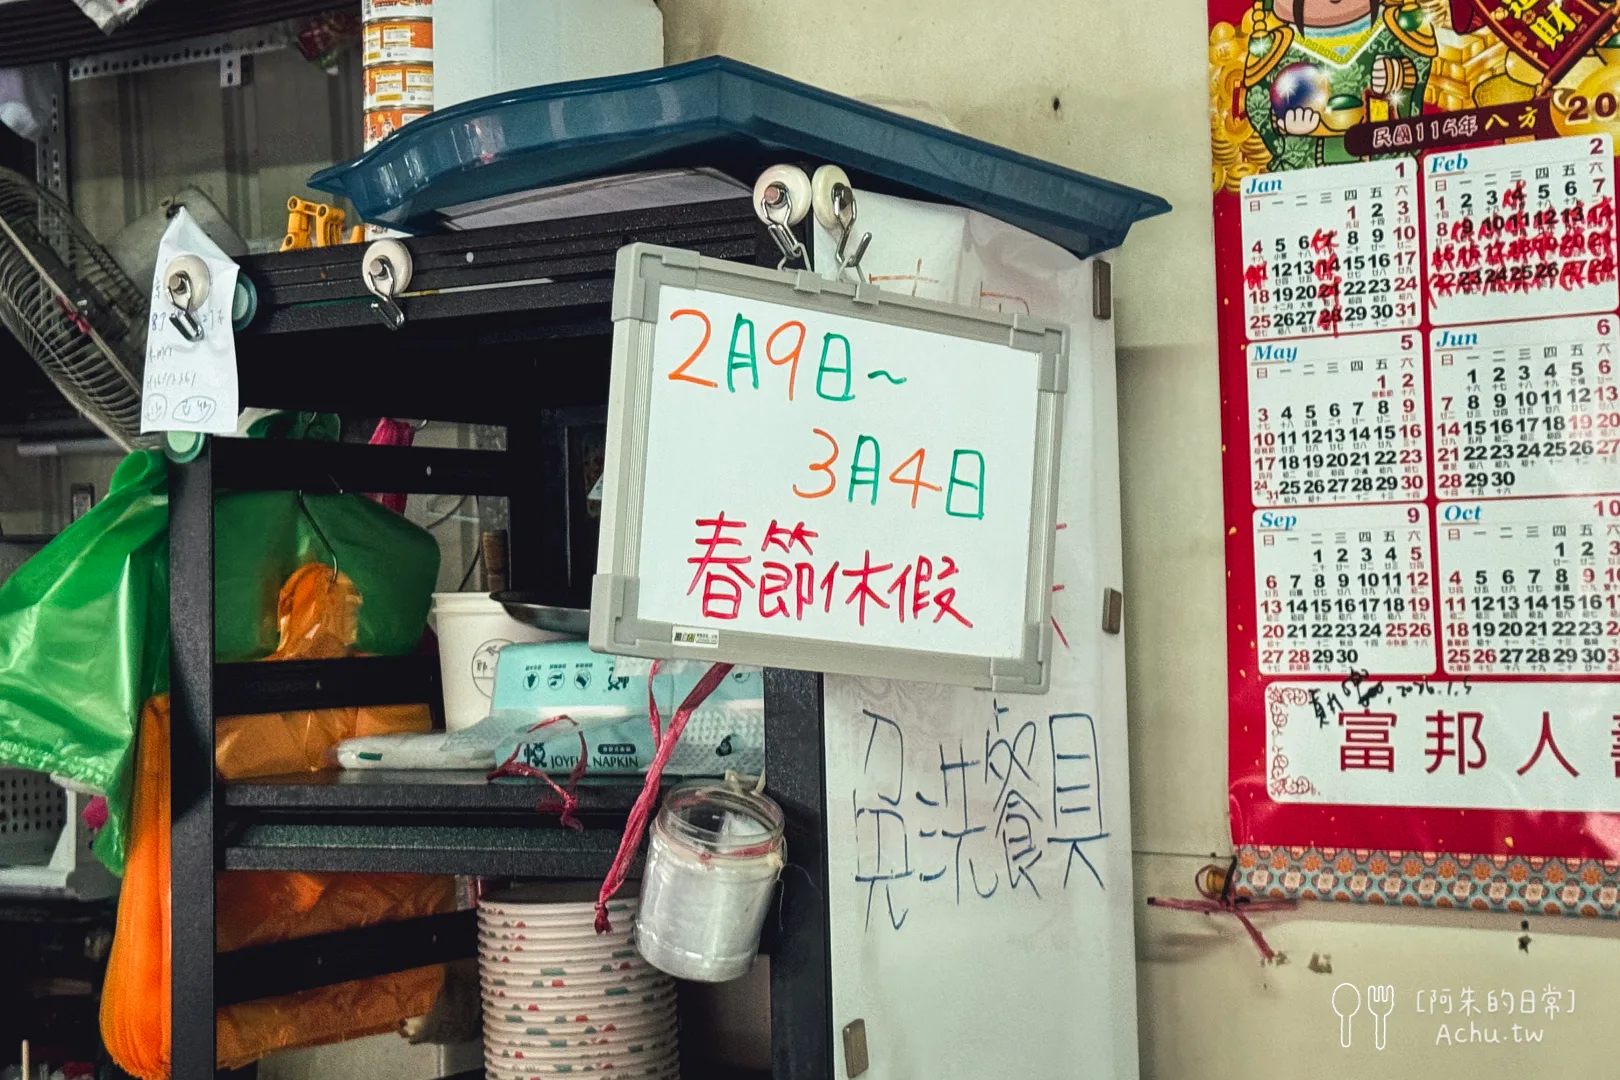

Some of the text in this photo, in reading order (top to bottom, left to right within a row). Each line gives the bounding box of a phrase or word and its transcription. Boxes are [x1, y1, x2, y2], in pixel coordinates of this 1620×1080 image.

[1528, 2, 1576, 51] 財
[1431, 139, 1604, 173] Feb 2
[1246, 163, 1406, 194] Jan 1
[1436, 178, 1605, 212] 1 2 3 5 6 7
[1348, 201, 1408, 219] 1 2 3
[1252, 226, 1416, 254] 4 5 8 9 10
[1272, 251, 1416, 277] 12 13 15 16 17
[1249, 276, 1418, 304] 18 19 20 22 23 24
[1250, 302, 1416, 329] 25 26 29 30 31
[1436, 320, 1610, 348] Jun 6
[1253, 335, 1414, 362] May 5
[1441, 355, 1454, 366] 日
[1493, 350, 1506, 362] 二
[1518, 349, 1531, 361] 三
[1544, 346, 1558, 358] 四
[1570, 344, 1584, 357] 五
[1597, 343, 1611, 355] 六
[1378, 374, 1414, 388] 1 2
[1468, 360, 1611, 384] 1 2 3 4 5 6
[1258, 399, 1414, 422] 3 4 5 6 7 8 9
[1442, 390, 1561, 411] 7 8 9 10 11
[1254, 424, 1422, 446] 10 11 12 13 14 15 16
[1437, 416, 1565, 437] 14 15 16 17 18
[1255, 449, 1422, 470] 17 18 19 20 21 22 23
[1438, 440, 1594, 462] 21 22 23 24 25 26
[792, 428, 985, 520] 3月4日
[1260, 508, 1420, 530] Sep 9
[1444, 500, 1620, 521] Oct 10
[1314, 546, 1422, 563] 1 2 3 4 5
[1556, 542, 1594, 556] 1 2
[687, 511, 973, 628] 春節休假
[1266, 572, 1428, 589] 6 7 8 9 10 11 12
[1450, 570, 1540, 585] 4 5 6 7
[1261, 598, 1430, 614] 13 14 16 17 18 19
[1445, 594, 1602, 612] 11 12 13 14 15 16
[1263, 623, 1432, 638] 20 21 22 23 24 25 26
[1446, 621, 1603, 637] 18 19 20 21 22 23
[1263, 649, 1358, 665] 27 28 29 30
[1338, 709, 1620, 779] 富邦人
[551, 755, 588, 769] JOYF
[593, 756, 638, 768] NAPKIN
